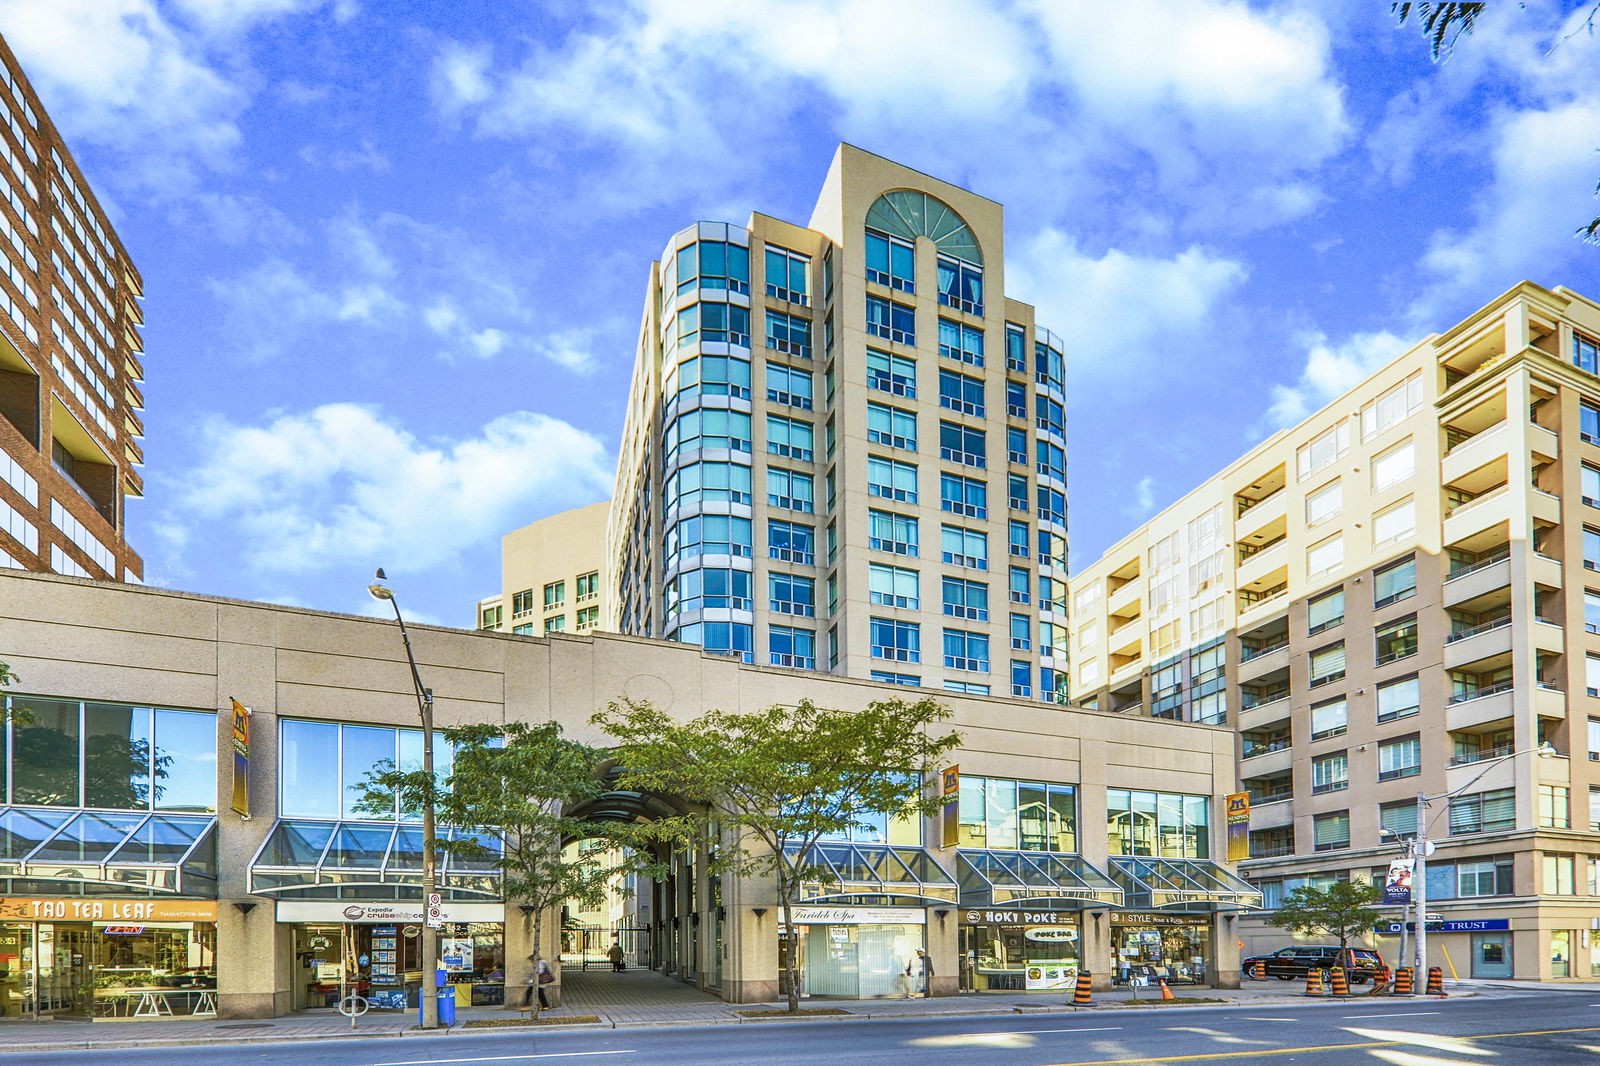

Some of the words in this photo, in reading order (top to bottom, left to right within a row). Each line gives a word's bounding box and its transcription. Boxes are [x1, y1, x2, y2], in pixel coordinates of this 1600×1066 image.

[32, 901, 65, 918] TAO
[72, 902, 103, 919] TEA
[113, 902, 155, 919] LEAF
[792, 908, 830, 919] Farideh
[833, 909, 855, 922] Spa
[985, 911, 1019, 923] HOKI
[1127, 914, 1151, 923] STYLE
[1449, 921, 1488, 929] TRUST
